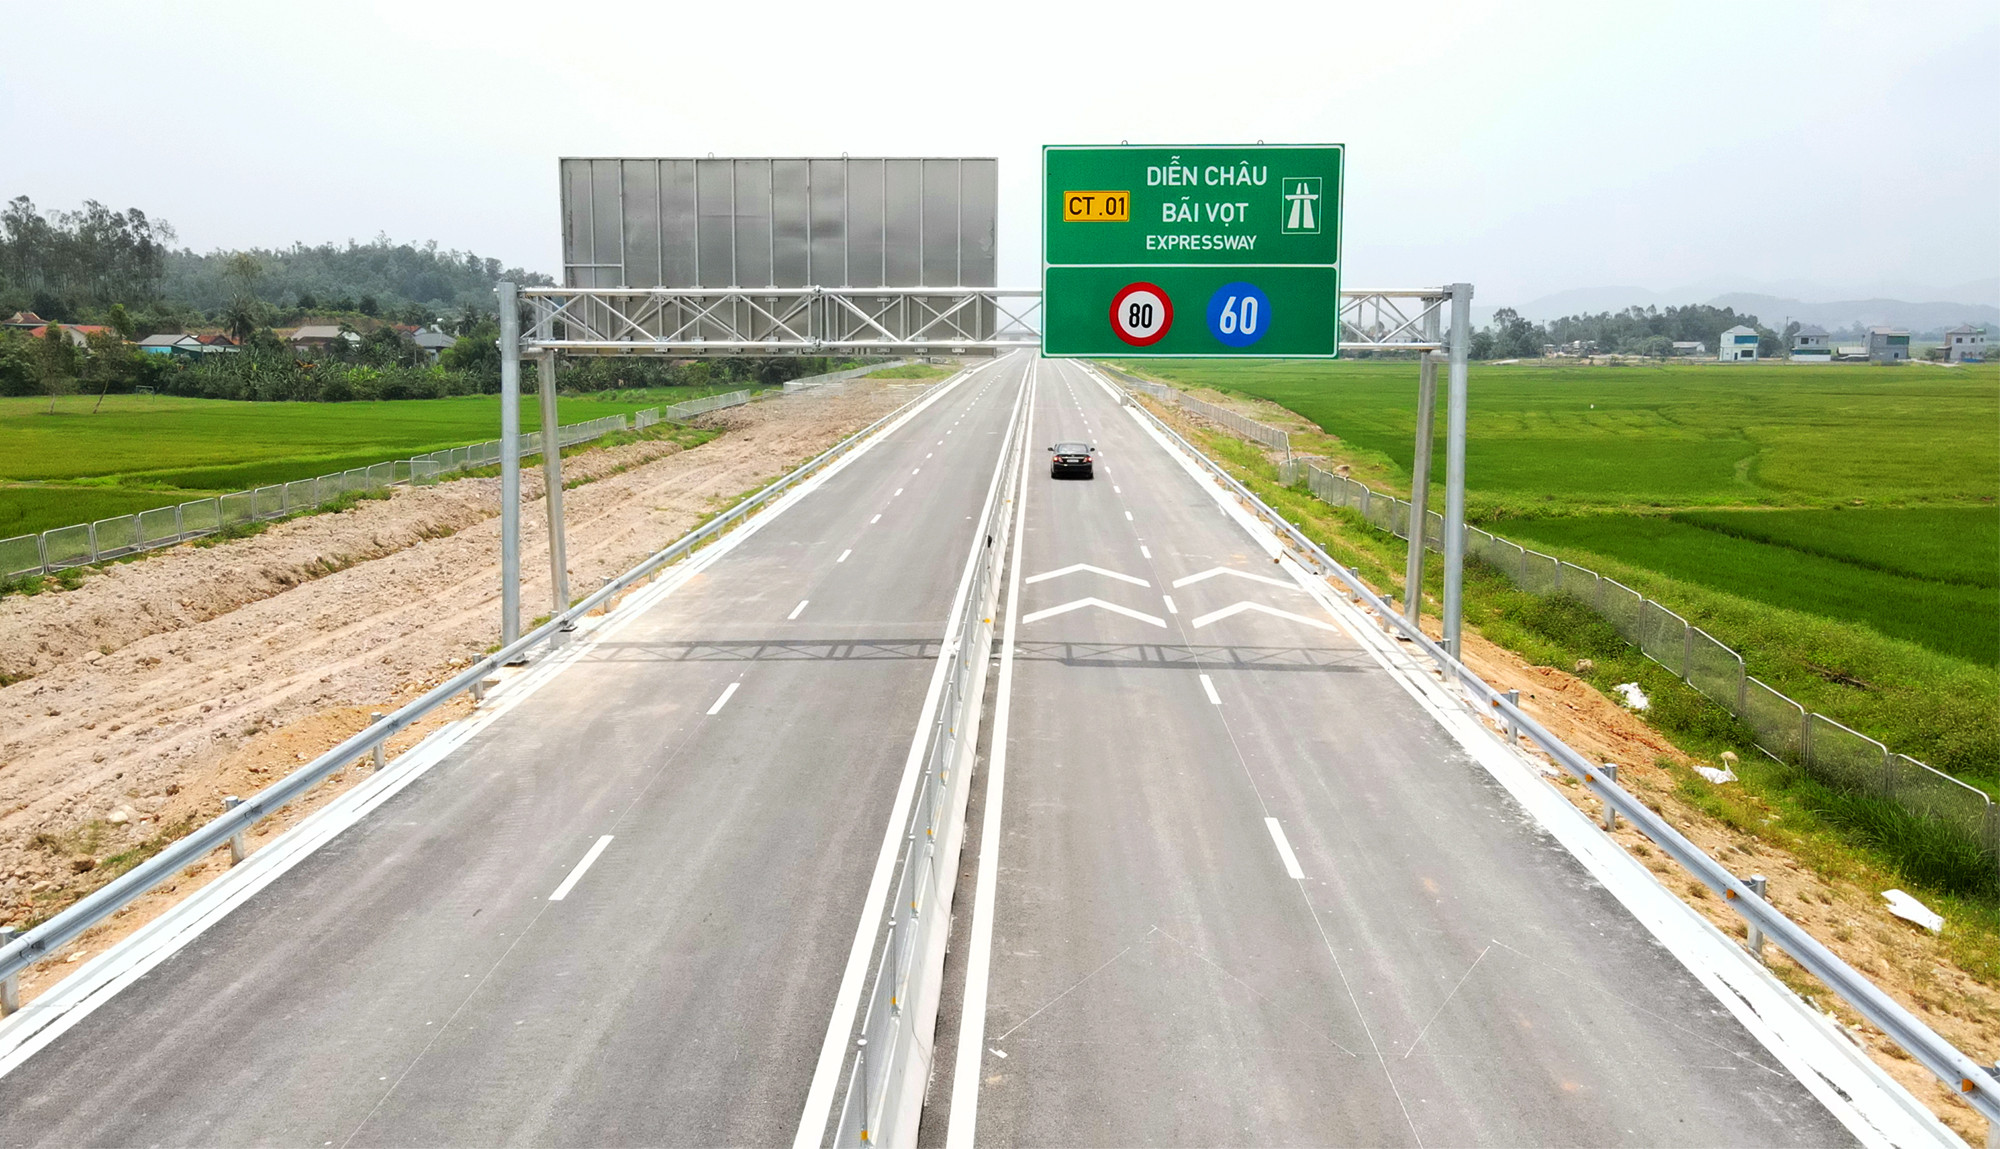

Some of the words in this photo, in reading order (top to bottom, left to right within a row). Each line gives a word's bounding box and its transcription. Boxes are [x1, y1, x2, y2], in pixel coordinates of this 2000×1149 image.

[1147, 155, 1198, 186] DIỄN
[1204, 160, 1267, 186] CHÂU
[1162, 196, 1199, 222] BÃI
[1205, 202, 1249, 227] VỌT
[1146, 235, 1257, 250] EXPRESSWAY
[1128, 303, 1153, 329] 80
[1219, 296, 1258, 335] 60
